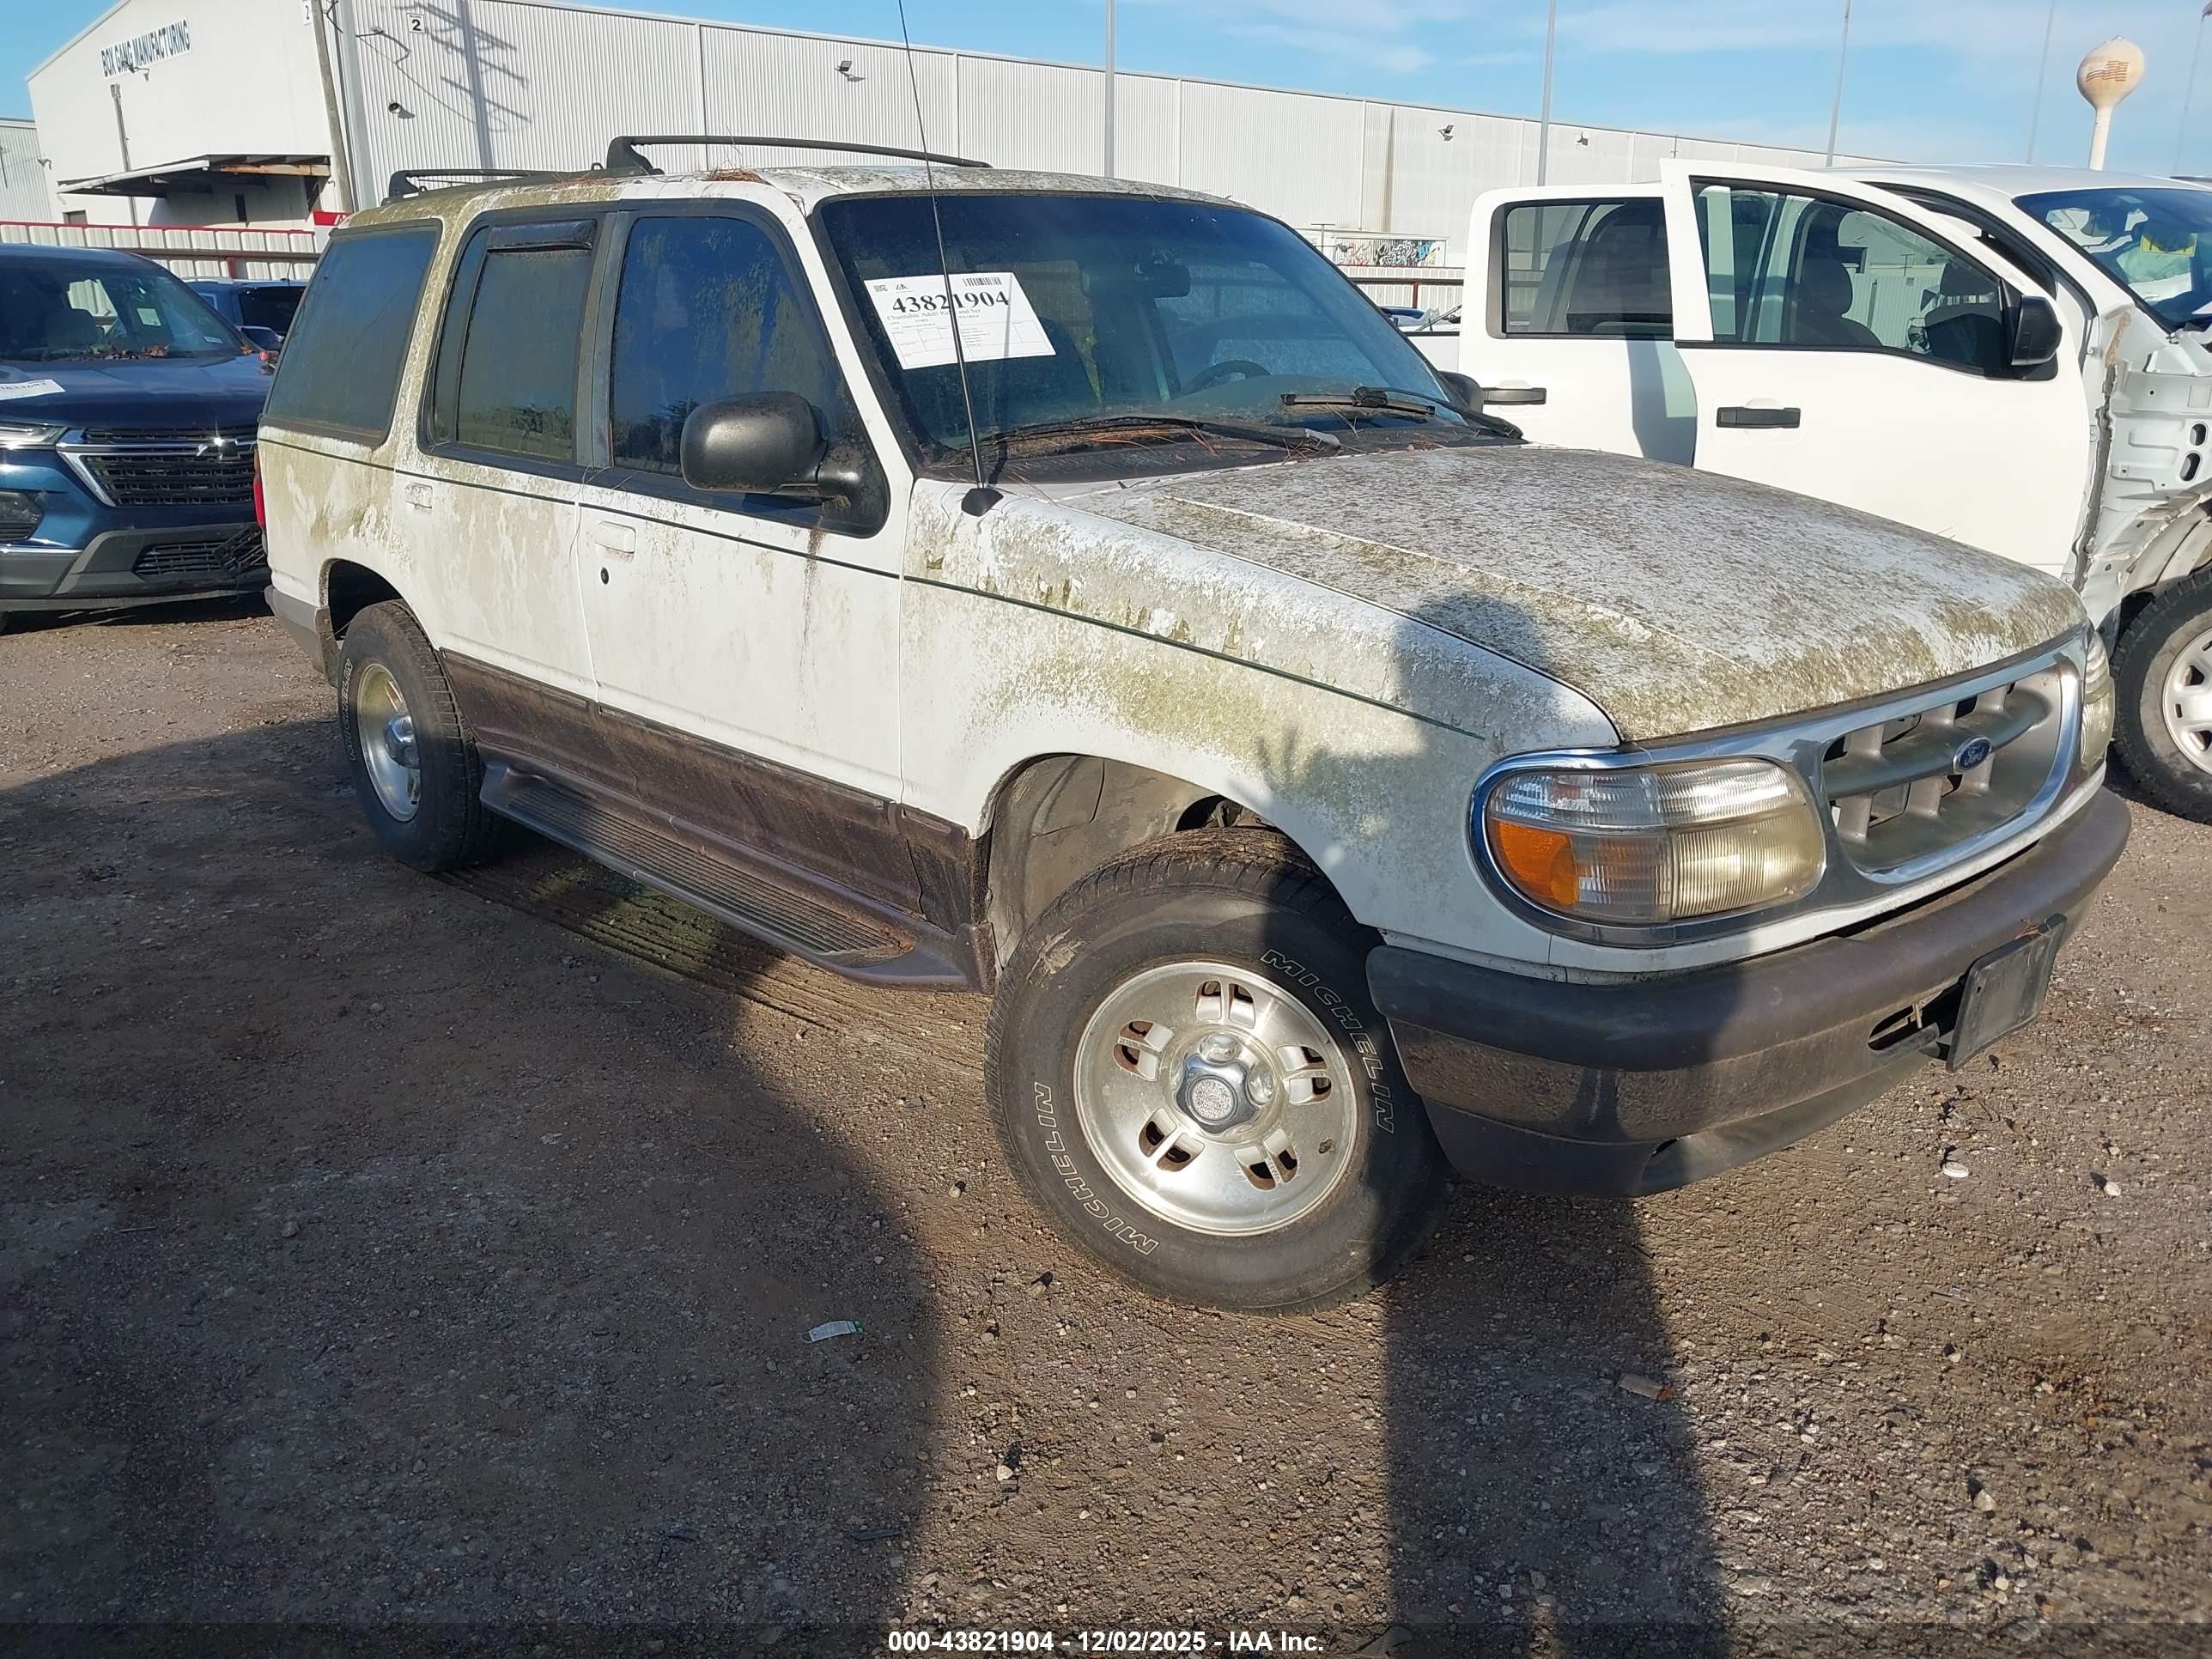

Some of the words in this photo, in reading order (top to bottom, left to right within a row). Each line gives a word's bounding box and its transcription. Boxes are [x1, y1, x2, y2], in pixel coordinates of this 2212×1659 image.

[100, 46, 117, 77] BOX
[114, 40, 134, 73] GANG
[131, 19, 190, 66] MANUFACTURING
[411, 19, 422, 31] 2
[893, 290, 1009, 313] 43821904
[1261, 949, 1396, 1133] MICHELIN
[1034, 1082, 1159, 1255] MICHELIN
